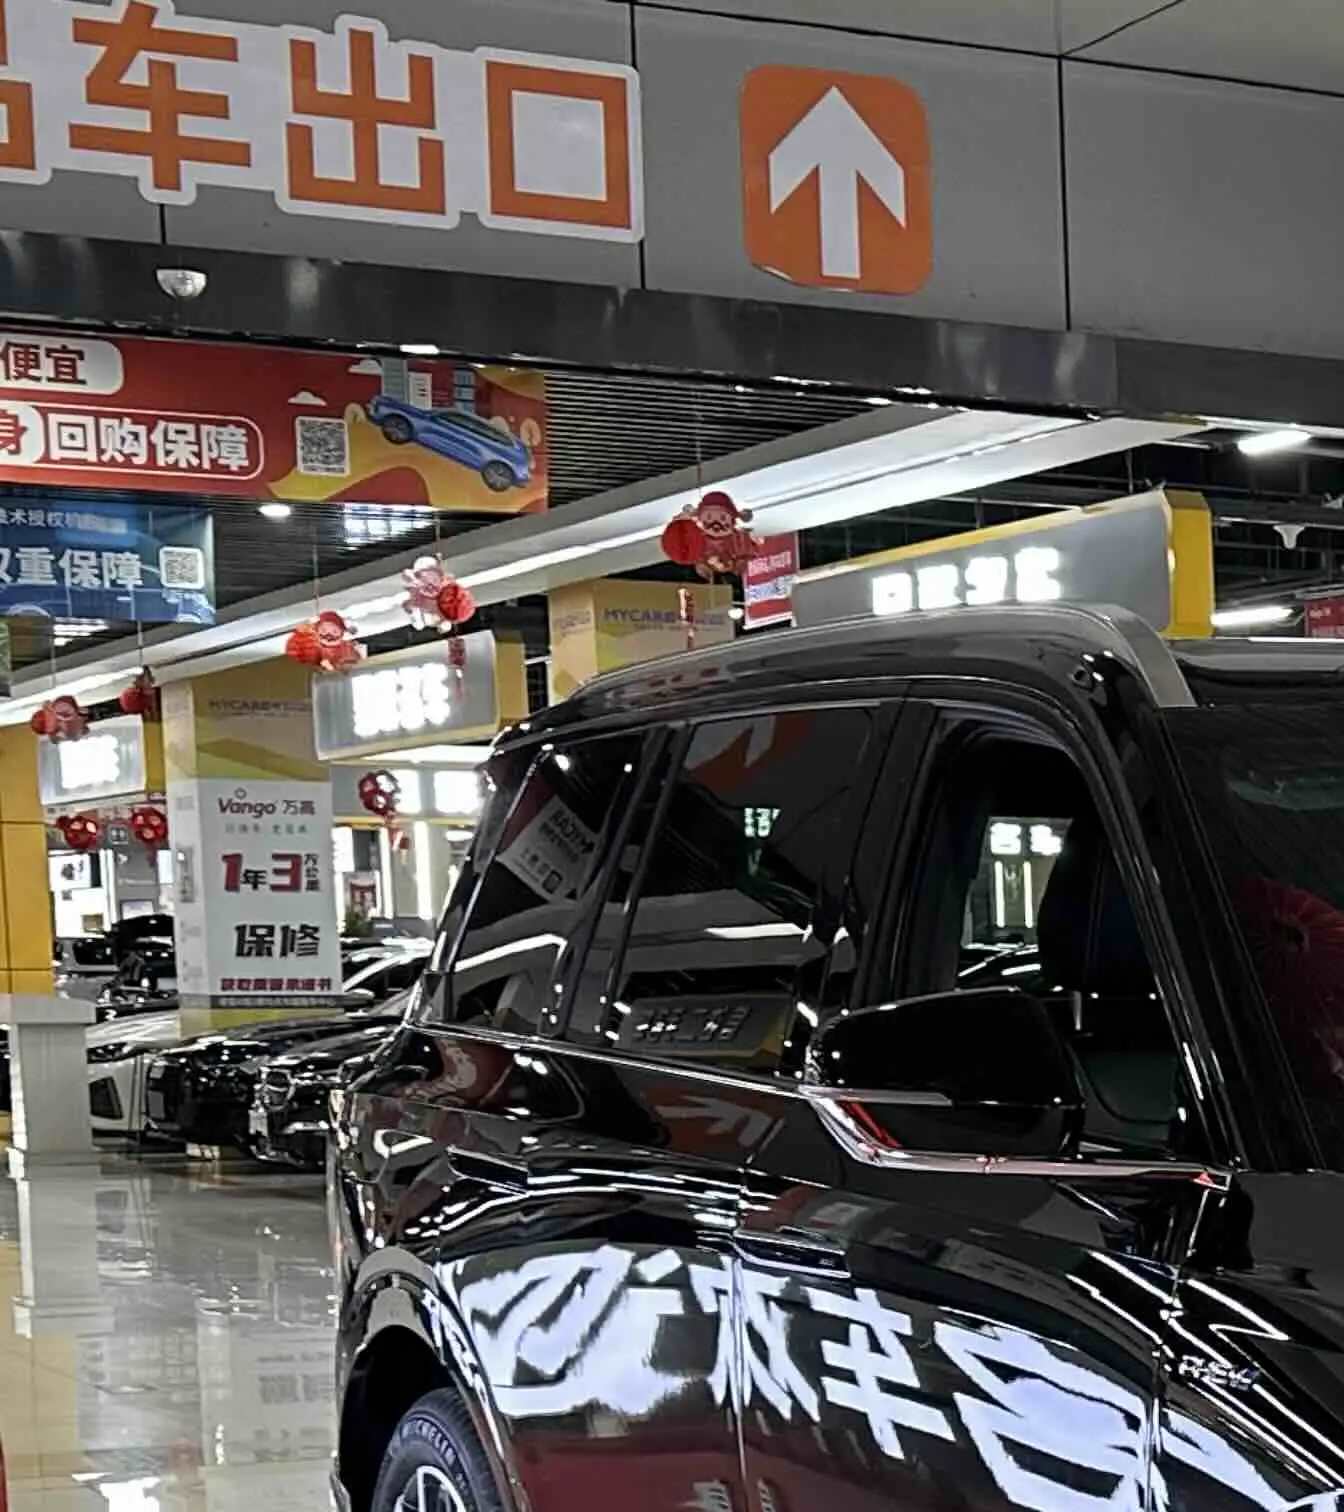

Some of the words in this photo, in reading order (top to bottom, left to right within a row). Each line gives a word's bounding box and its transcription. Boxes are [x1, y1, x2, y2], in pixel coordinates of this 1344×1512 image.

[48, 412, 250, 472] 回购保障
[218, 797, 277, 818] Vango
[234, 923, 321, 958] 保修
